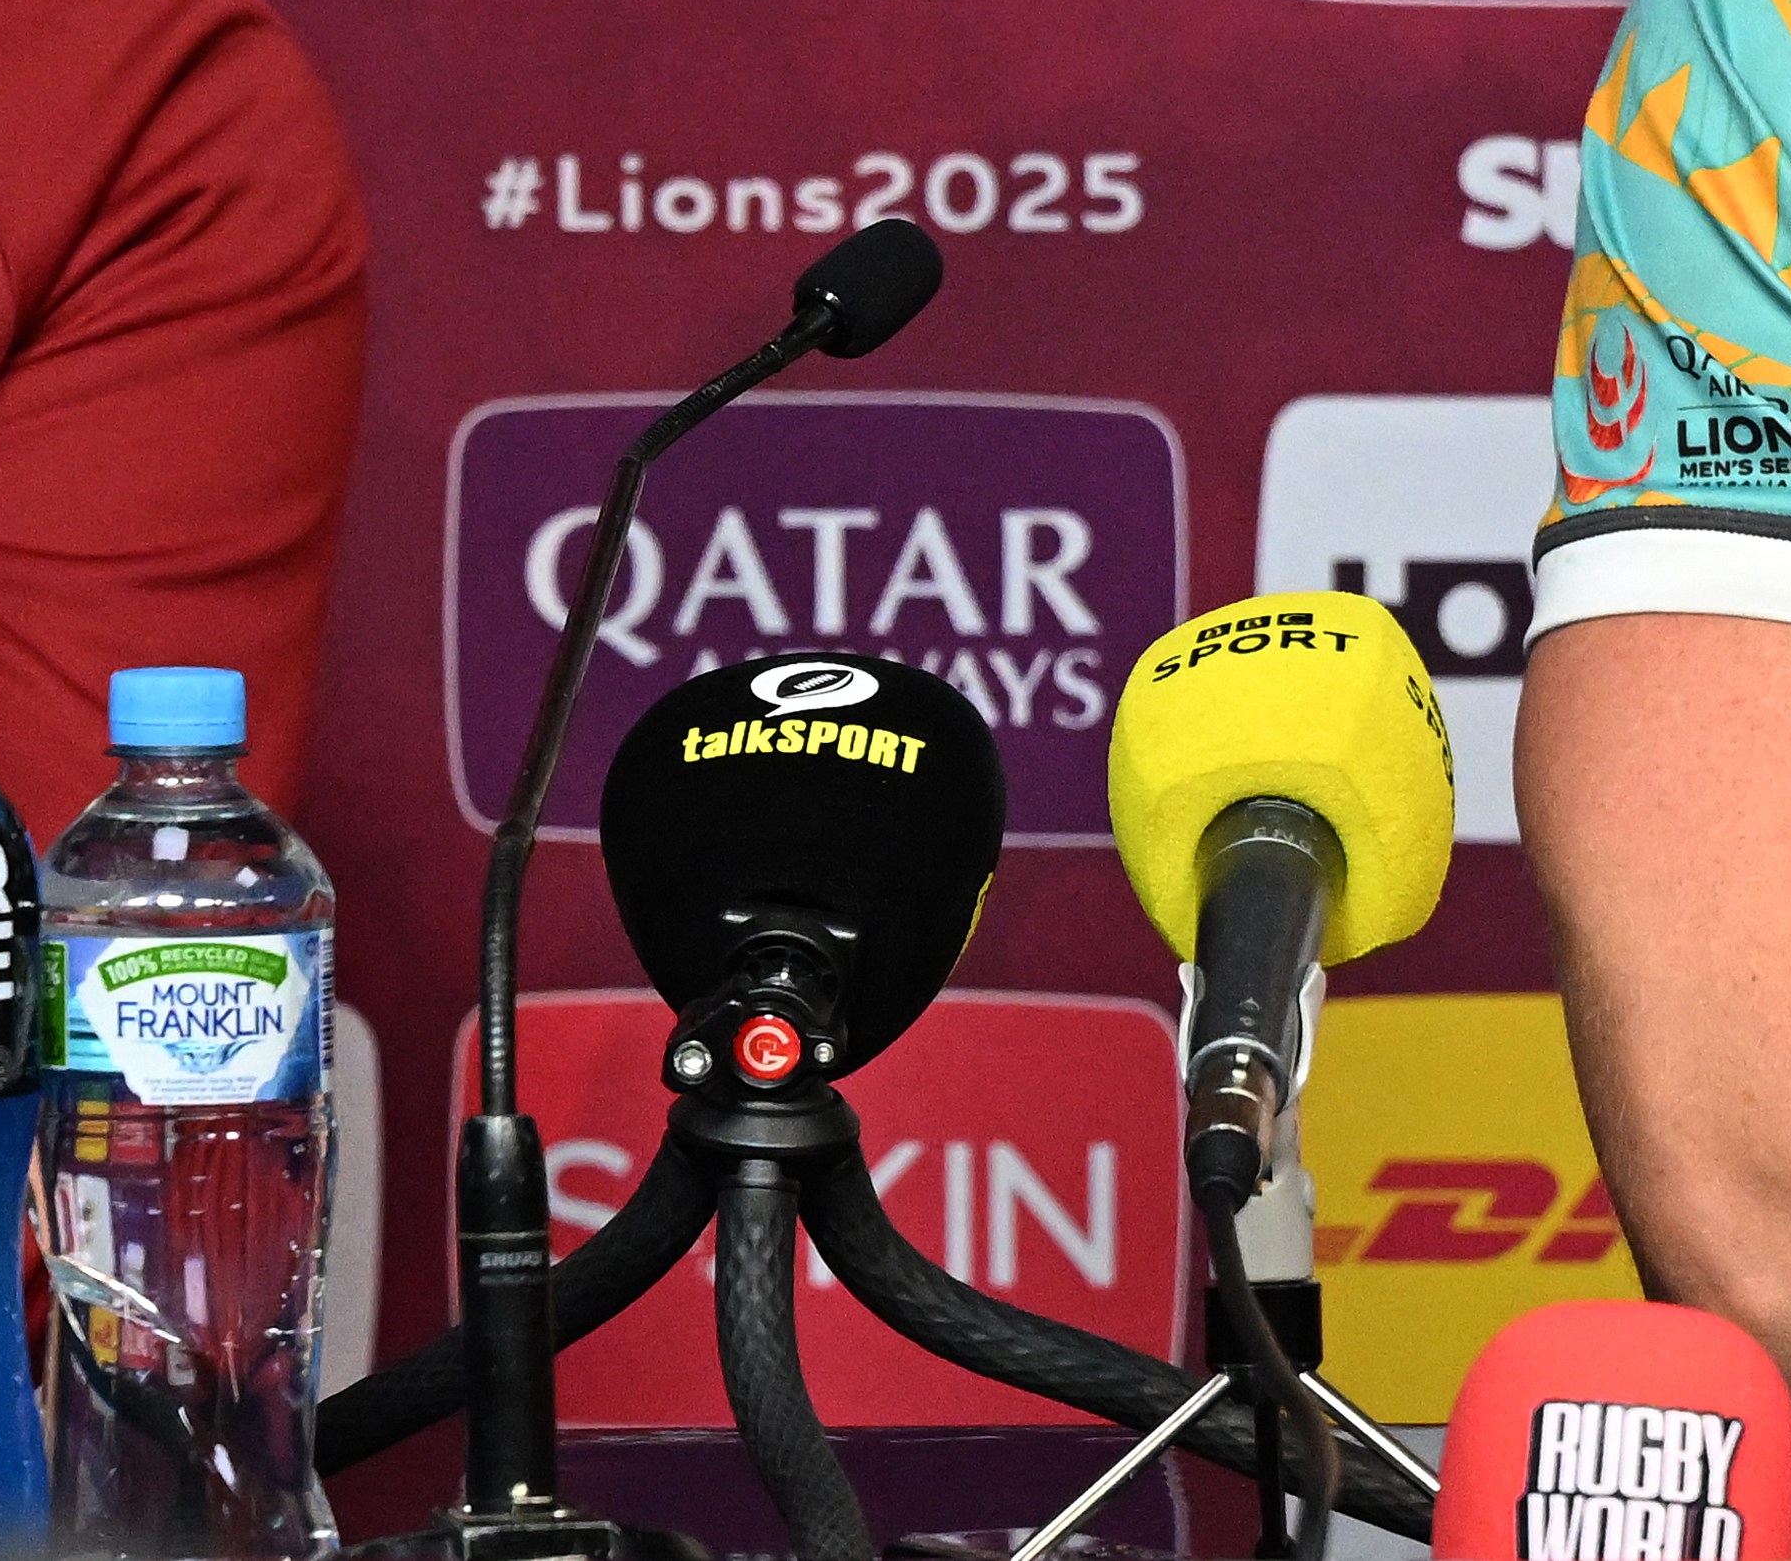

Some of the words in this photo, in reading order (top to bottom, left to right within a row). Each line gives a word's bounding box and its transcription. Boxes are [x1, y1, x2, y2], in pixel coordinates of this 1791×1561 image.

[482, 151, 1144, 235] #Lions2025
[1680, 458, 1753, 479] MEN'S
[523, 505, 1102, 667] QATAR
[1197, 613, 1313, 643] BBC
[1153, 630, 1359, 682] SPORT
[683, 719, 926, 774] talkSPORT
[105, 953, 158, 984] 100%
[160, 947, 248, 963] RECYCLED
[153, 982, 256, 1006] MOUNT
[118, 1001, 285, 1039] FRANKLIN
[1535, 1401, 1743, 1507] RUGBY
